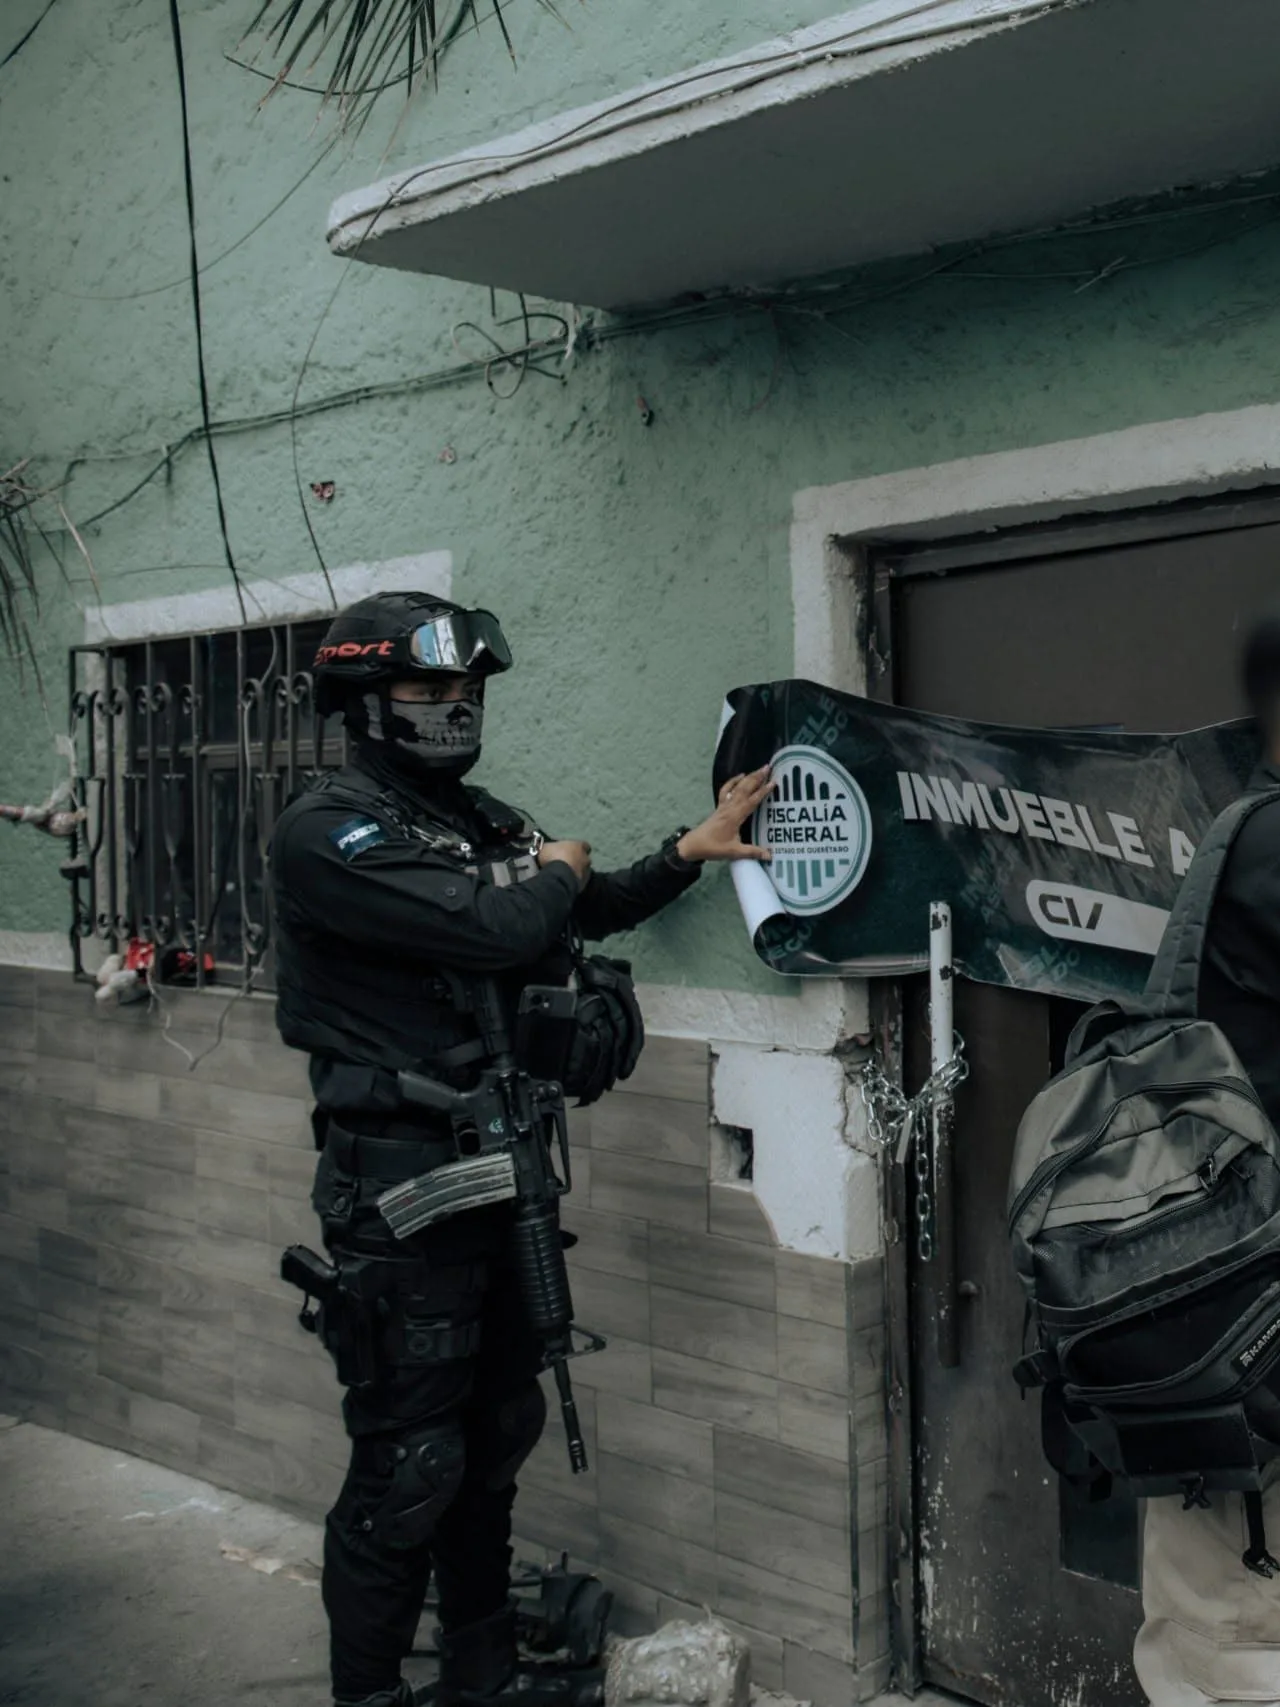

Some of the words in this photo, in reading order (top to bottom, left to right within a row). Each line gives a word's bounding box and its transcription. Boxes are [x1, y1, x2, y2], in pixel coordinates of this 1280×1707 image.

[766, 803, 847, 824] FISCALÍA
[896, 771, 1155, 868] INMUEBLE
[767, 825, 849, 844] GENERAL
